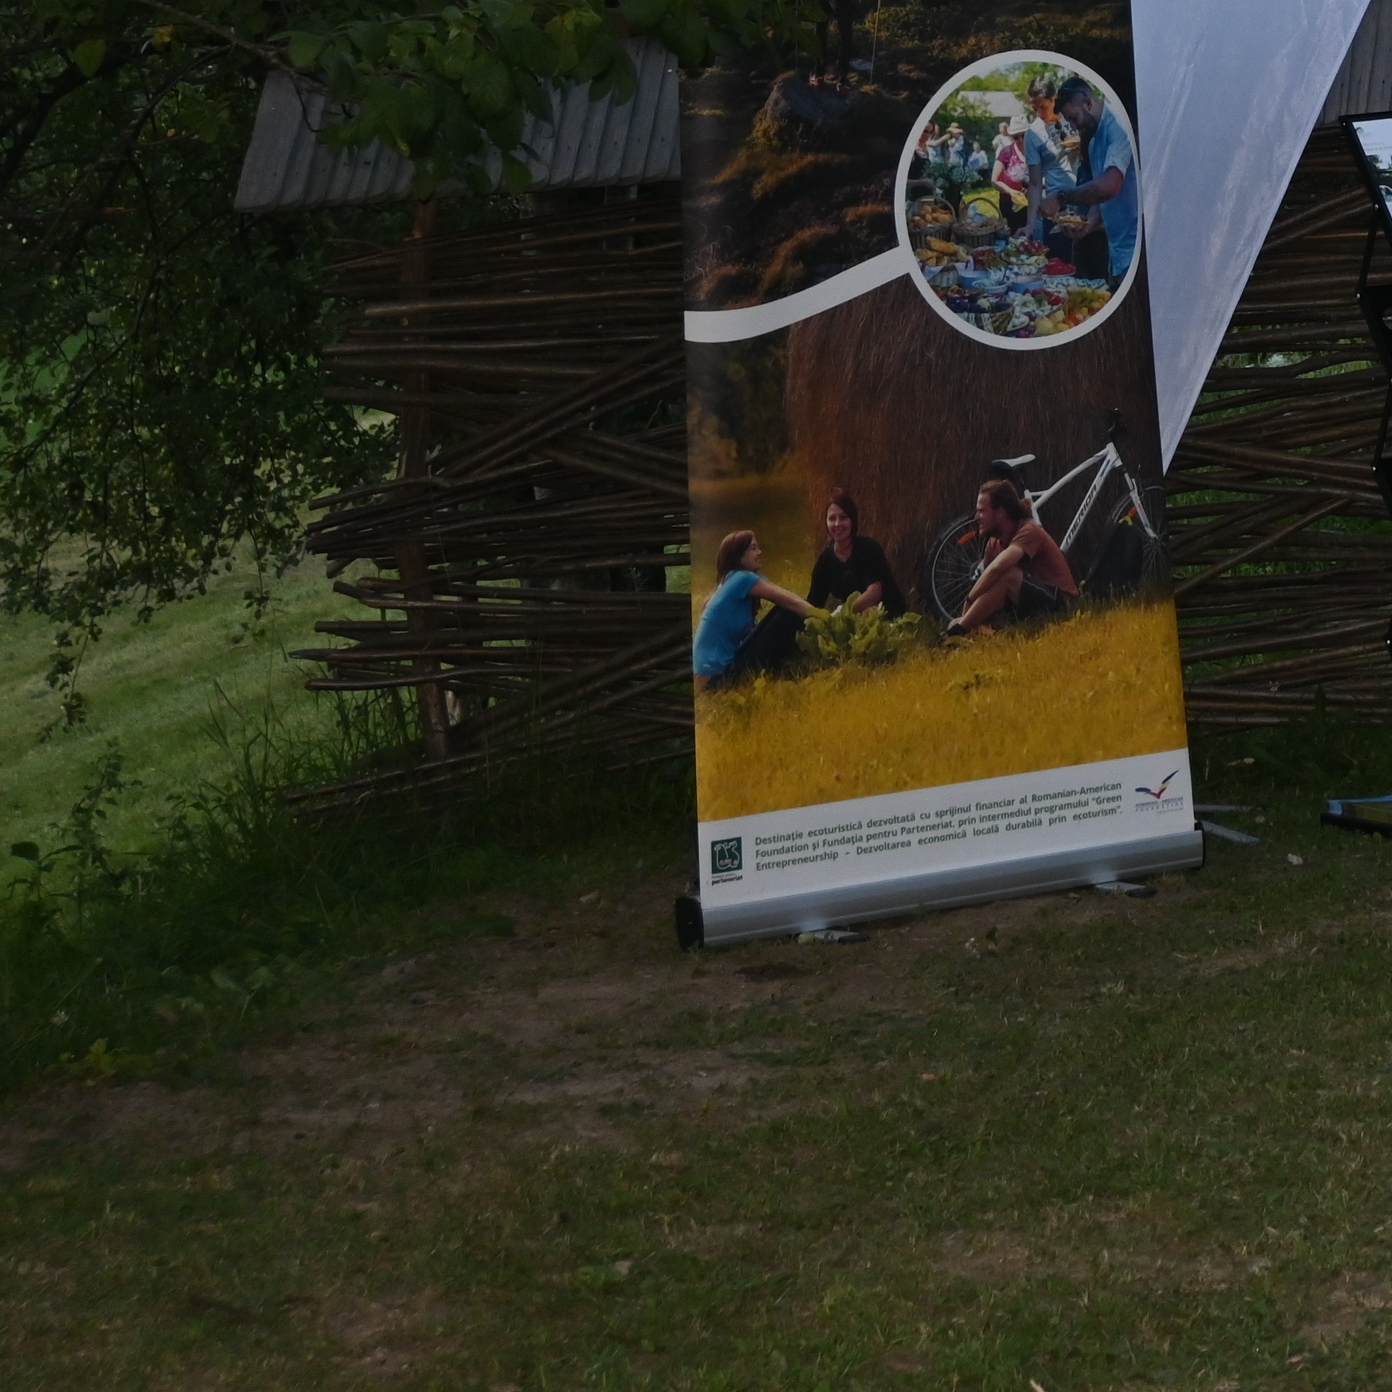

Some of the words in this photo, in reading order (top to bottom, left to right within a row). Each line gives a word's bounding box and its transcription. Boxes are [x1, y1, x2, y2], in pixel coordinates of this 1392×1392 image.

[755, 843, 809, 859] Foundation
[866, 829, 898, 844] pentru
[900, 820, 955, 836] Parteneriat,
[958, 816, 977, 829] prin
[979, 807, 1032, 823] intermediul
[1034, 798, 1090, 816] programului
[919, 810, 931, 821] cu
[935, 804, 972, 820] sprijinul
[975, 797, 1016, 812] financiar
[1019, 795, 1028, 805] al
[1031, 781, 1123, 803] Romanian-American
[756, 851, 839, 871] Entrepreneurship
[856, 840, 912, 856] Dezvoltarea
[1048, 815, 1067, 828] prin
